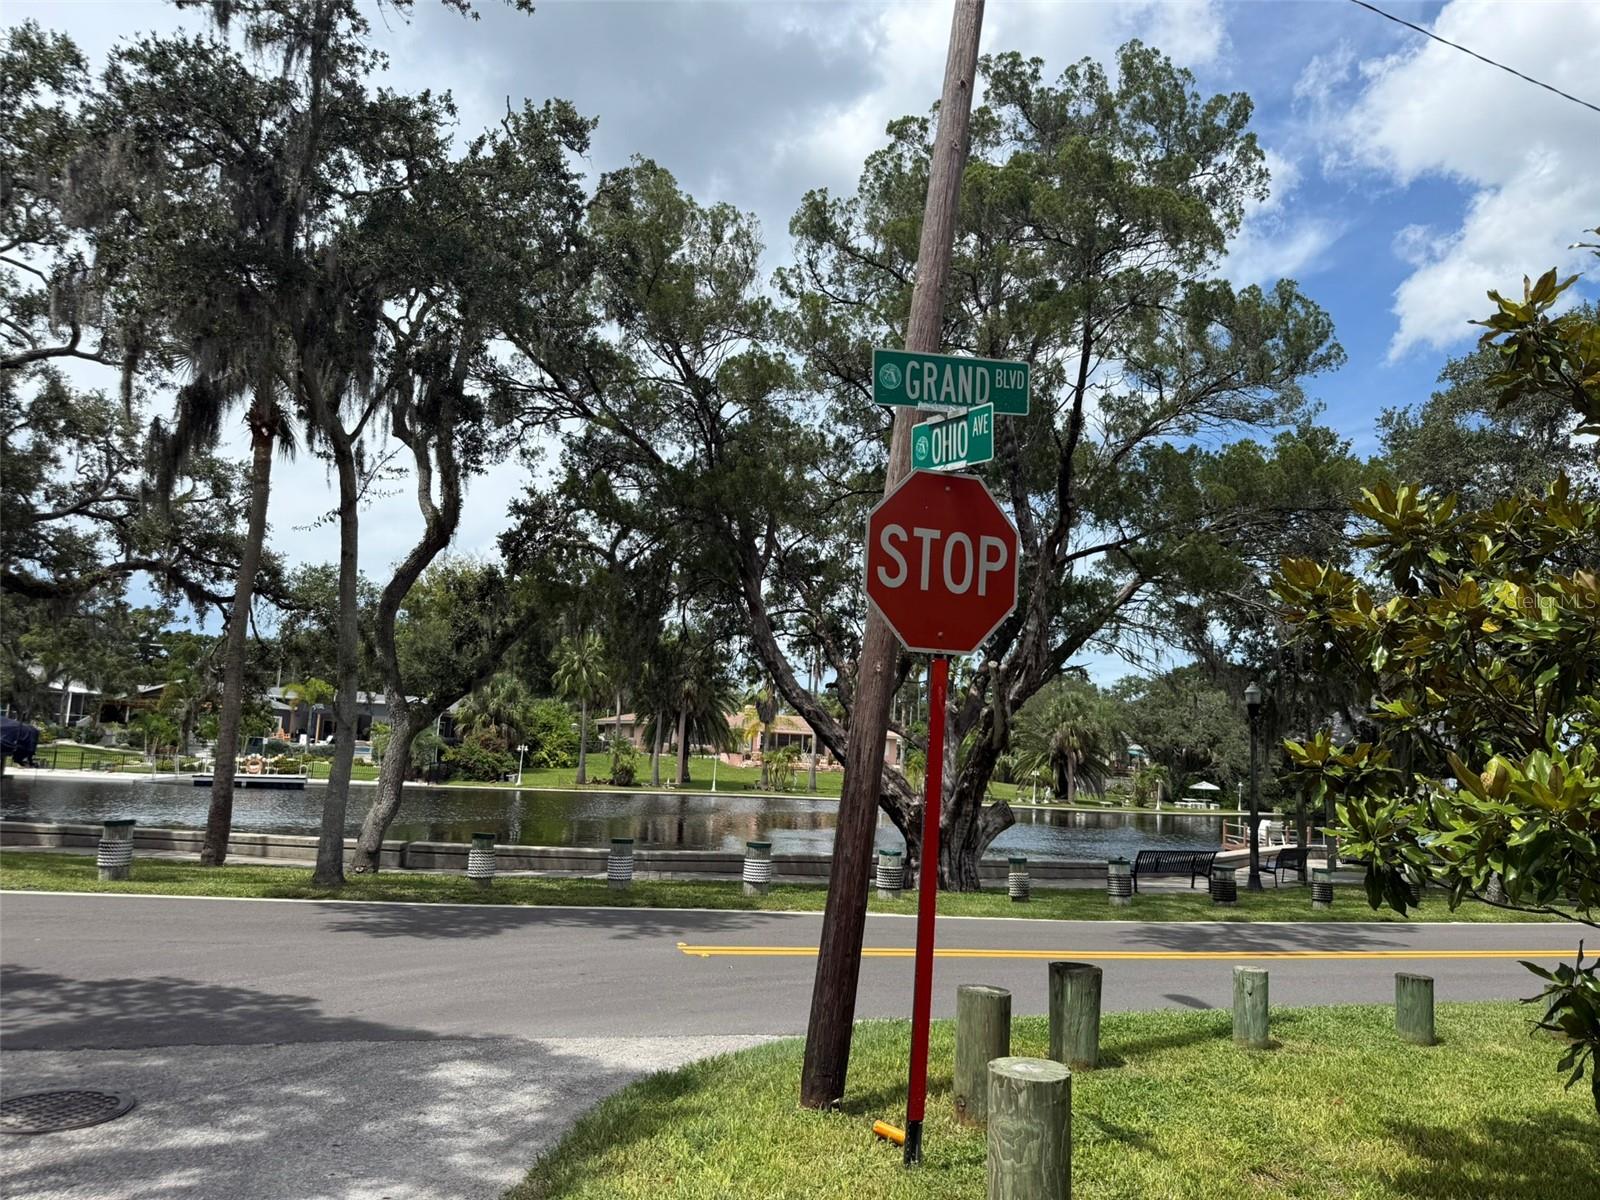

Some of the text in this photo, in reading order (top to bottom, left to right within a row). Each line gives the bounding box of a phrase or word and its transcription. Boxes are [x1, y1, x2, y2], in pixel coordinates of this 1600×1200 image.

[905, 360, 1025, 404] GRAND BLVD
[931, 413, 989, 465] OHIO AVE
[876, 523, 1008, 597] STOP
